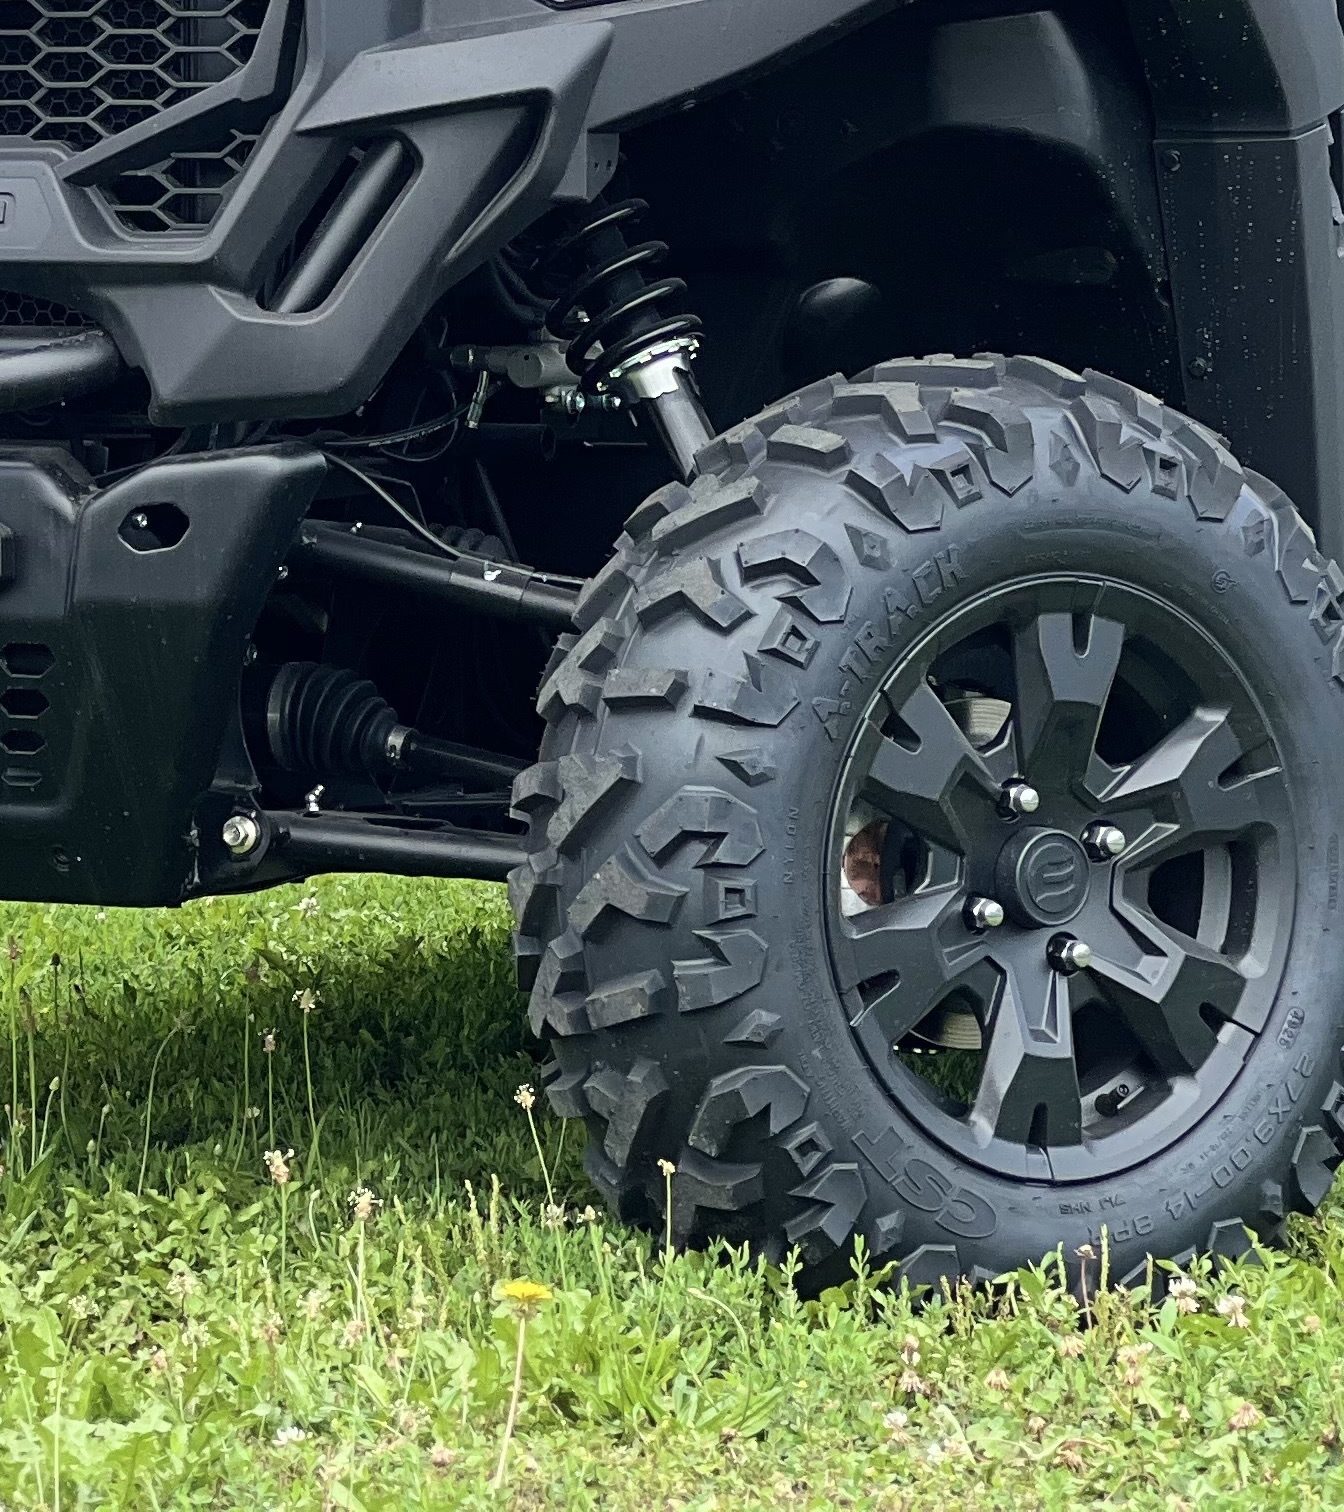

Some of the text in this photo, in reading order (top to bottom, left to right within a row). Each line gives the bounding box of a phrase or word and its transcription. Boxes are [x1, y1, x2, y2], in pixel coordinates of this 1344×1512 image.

[811, 543, 968, 744] A-TRACK
[783, 806, 800, 885] NYLON
[851, 1125, 998, 1239] CST
